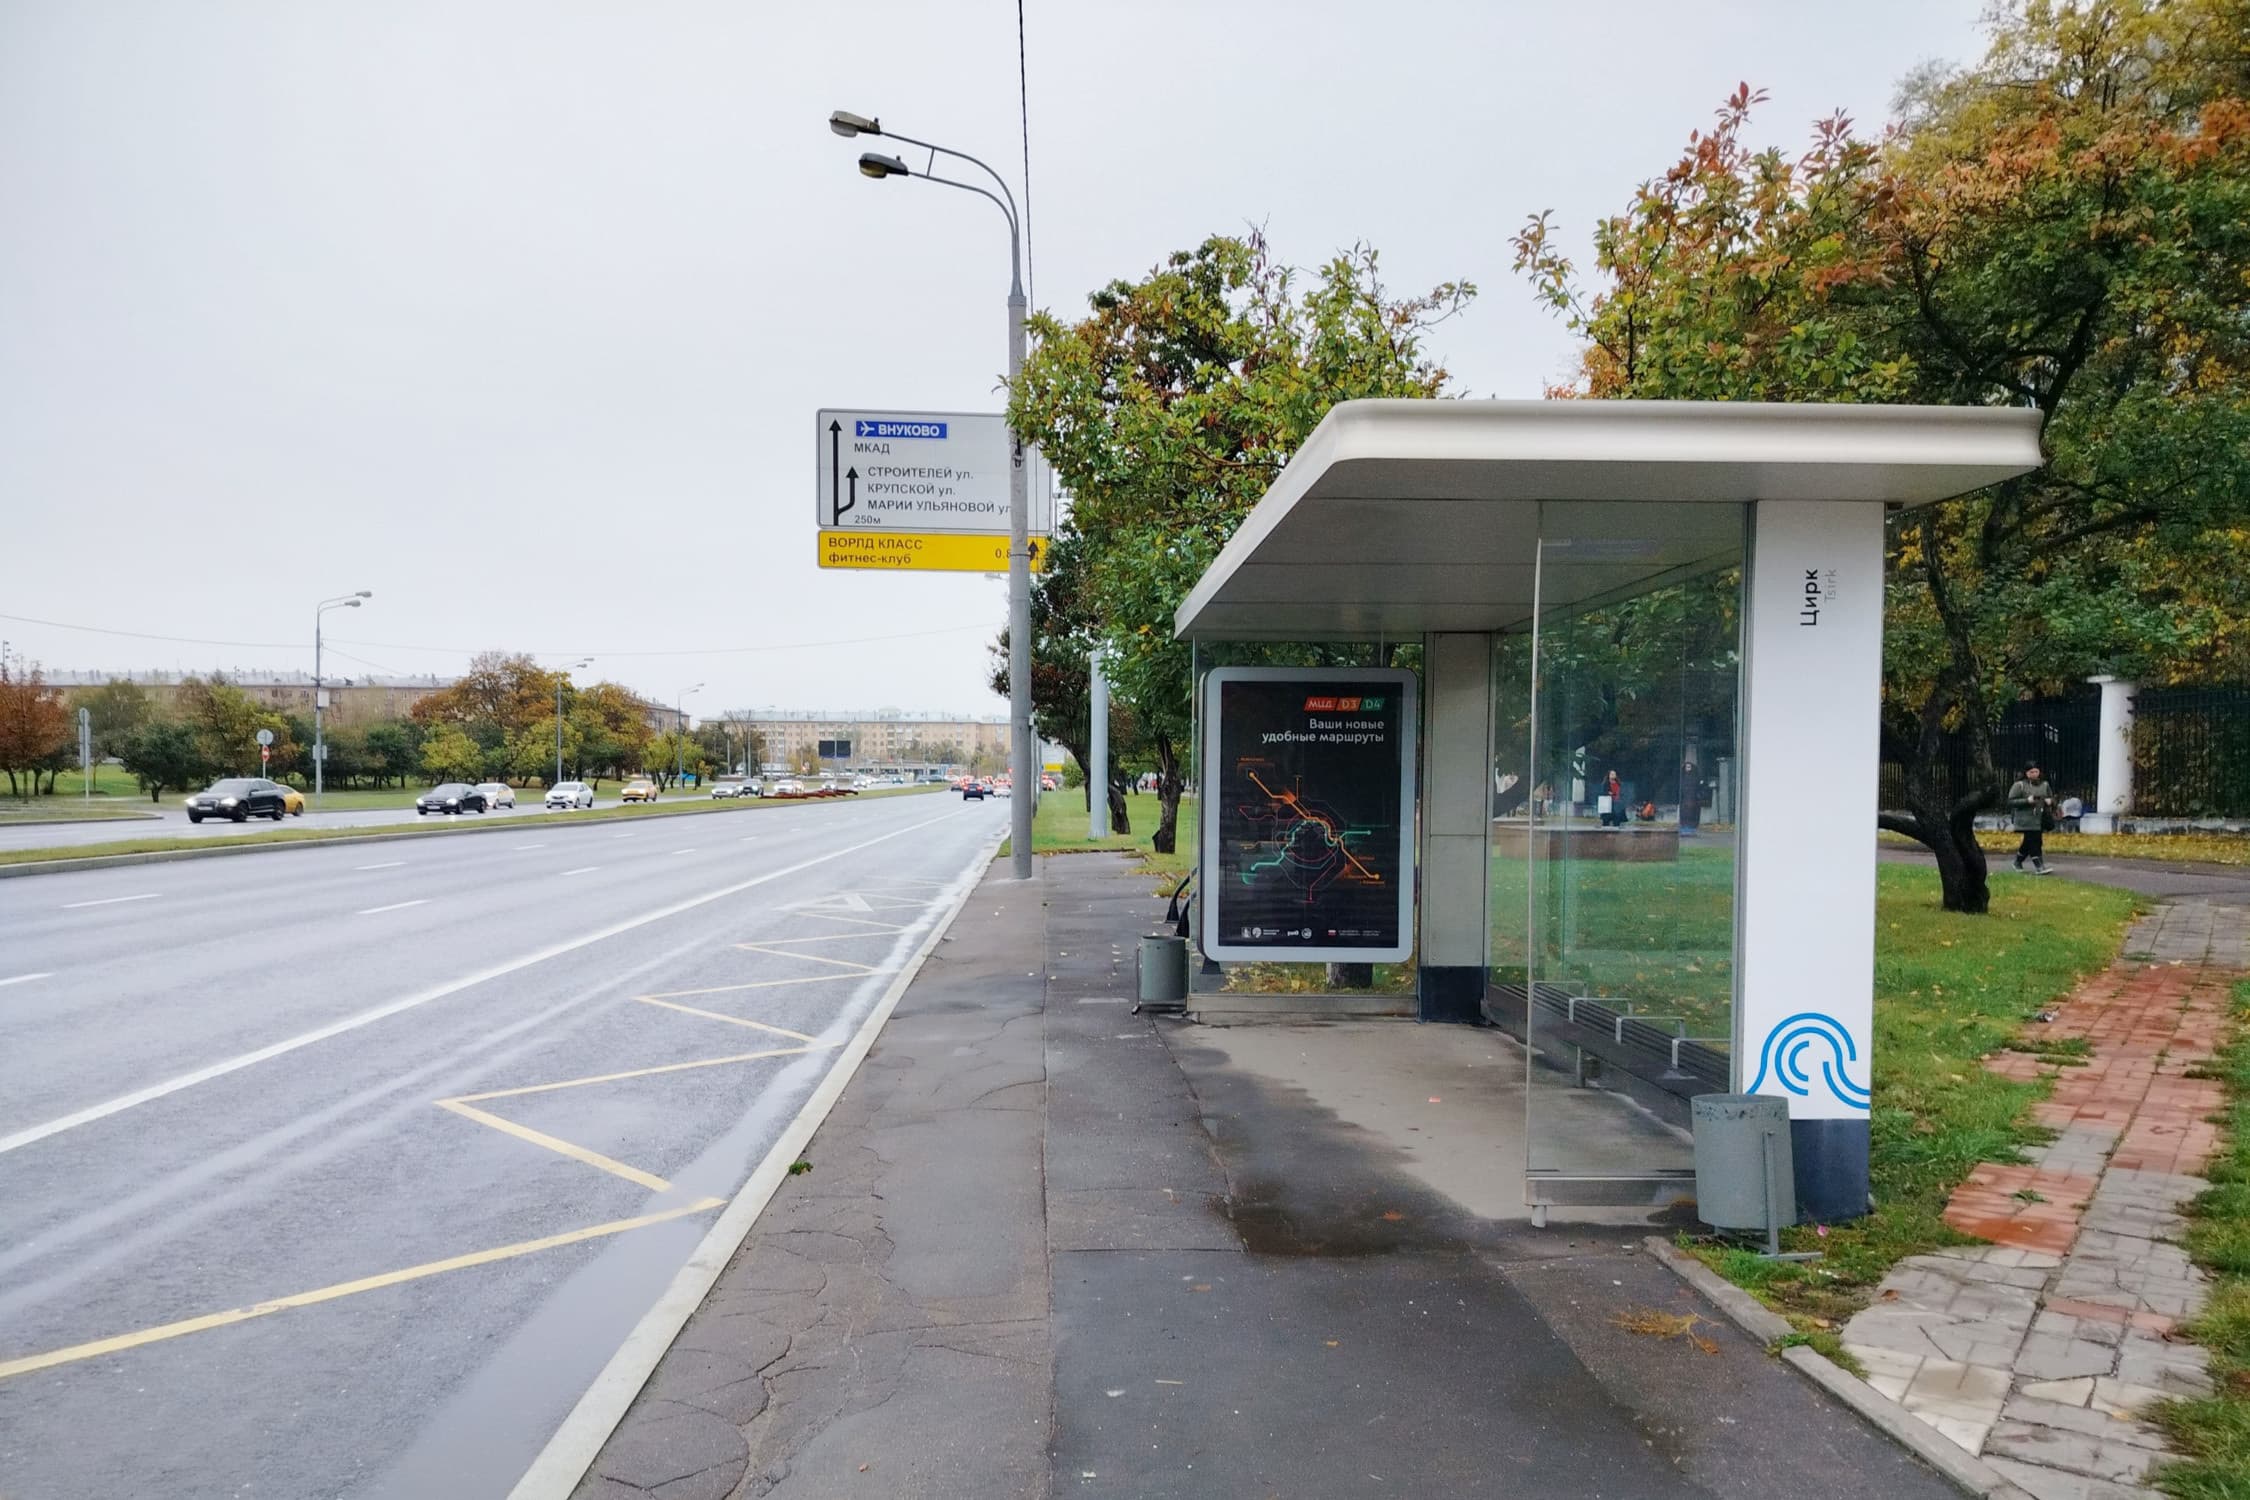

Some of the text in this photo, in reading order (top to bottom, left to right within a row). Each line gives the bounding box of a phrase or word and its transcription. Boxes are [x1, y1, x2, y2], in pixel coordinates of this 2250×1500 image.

[878, 424, 940, 437] ВНУКОВО
[854, 443, 890, 455] МКАД
[867, 466, 974, 481] СТРОИТЕЛЕЙ ул.
[867, 483, 956, 497] КРУПСКОЙ ул.
[867, 500, 913, 511] МАРИИ
[916, 501, 995, 512] УЛЬЯНОВОЙ
[854, 515, 881, 525] 250м
[828, 537, 923, 550] ВОРЛД КЛАСС
[828, 552, 912, 565] фитнес-клуб
[1824, 569, 1837, 602] Tsirk
[1800, 568, 1822, 626] Цирк
[1341, 699, 1357, 709] D3
[1365, 700, 1381, 709] D4
[1309, 718, 1385, 730] Ваши новые
[1261, 731, 1384, 744] удобные маршруты
